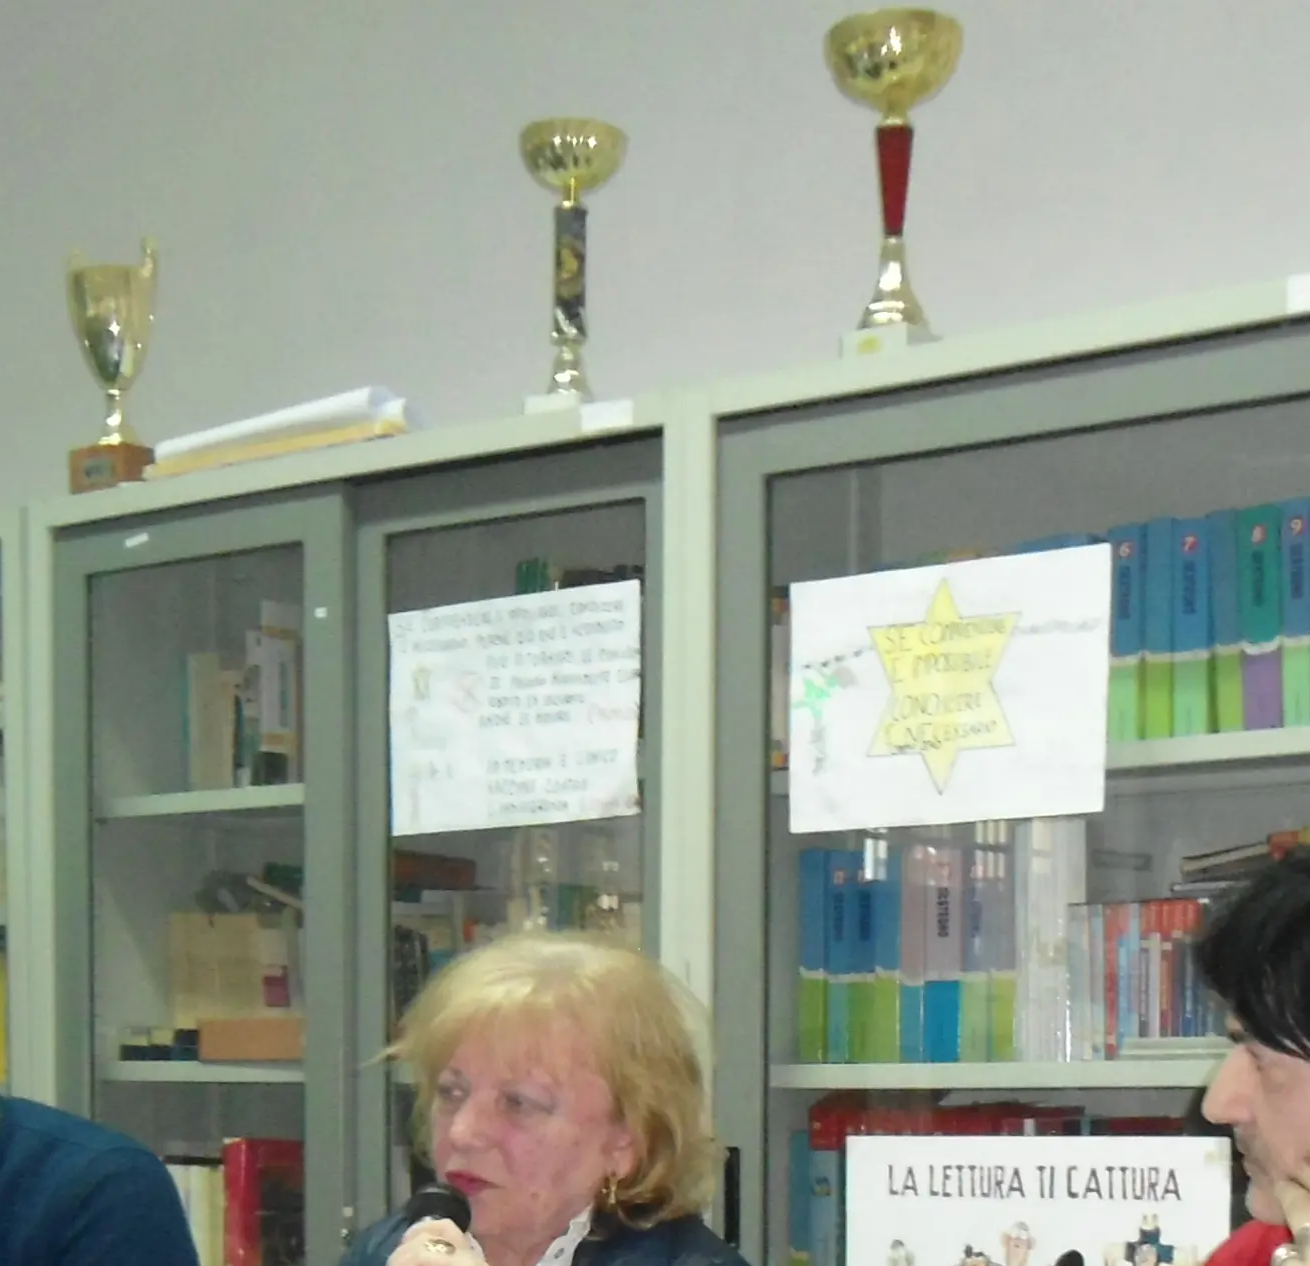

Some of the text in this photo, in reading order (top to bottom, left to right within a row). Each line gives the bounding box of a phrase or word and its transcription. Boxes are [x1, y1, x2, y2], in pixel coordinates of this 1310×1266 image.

[887, 1163, 1183, 1201] LA LETTURA TI CATTURA
